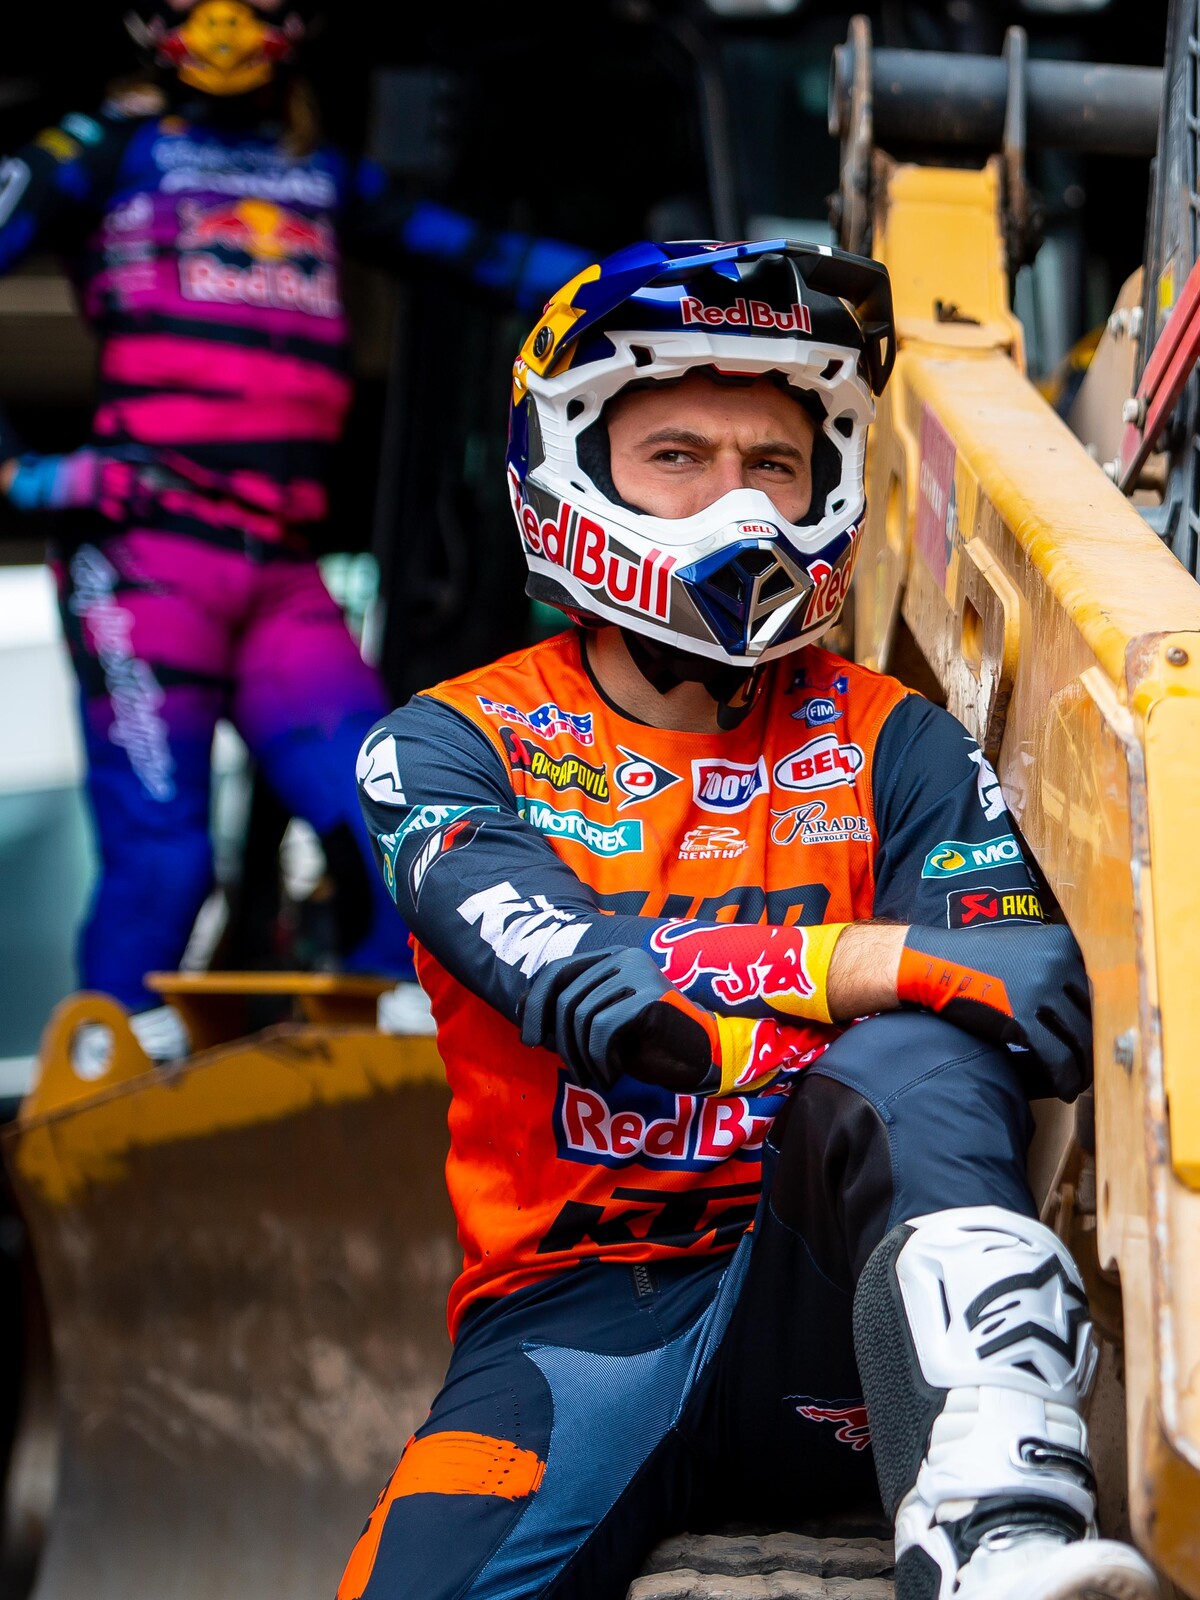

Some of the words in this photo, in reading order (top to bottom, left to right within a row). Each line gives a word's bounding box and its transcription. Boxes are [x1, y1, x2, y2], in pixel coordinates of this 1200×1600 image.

[681, 296, 749, 325] Red
[750, 301, 812, 334] Bull
[742, 525, 773, 535] BELL
[572, 515, 677, 619] Bull
[810, 704, 834, 717] FIM
[701, 771, 756, 800] 100%
[530, 805, 628, 852] MOTOREX
[803, 833, 848, 844] CHEVROLET
[972, 840, 1020, 865] MO
[1002, 894, 1044, 919] AKR
[562, 1083, 696, 1159] Red
